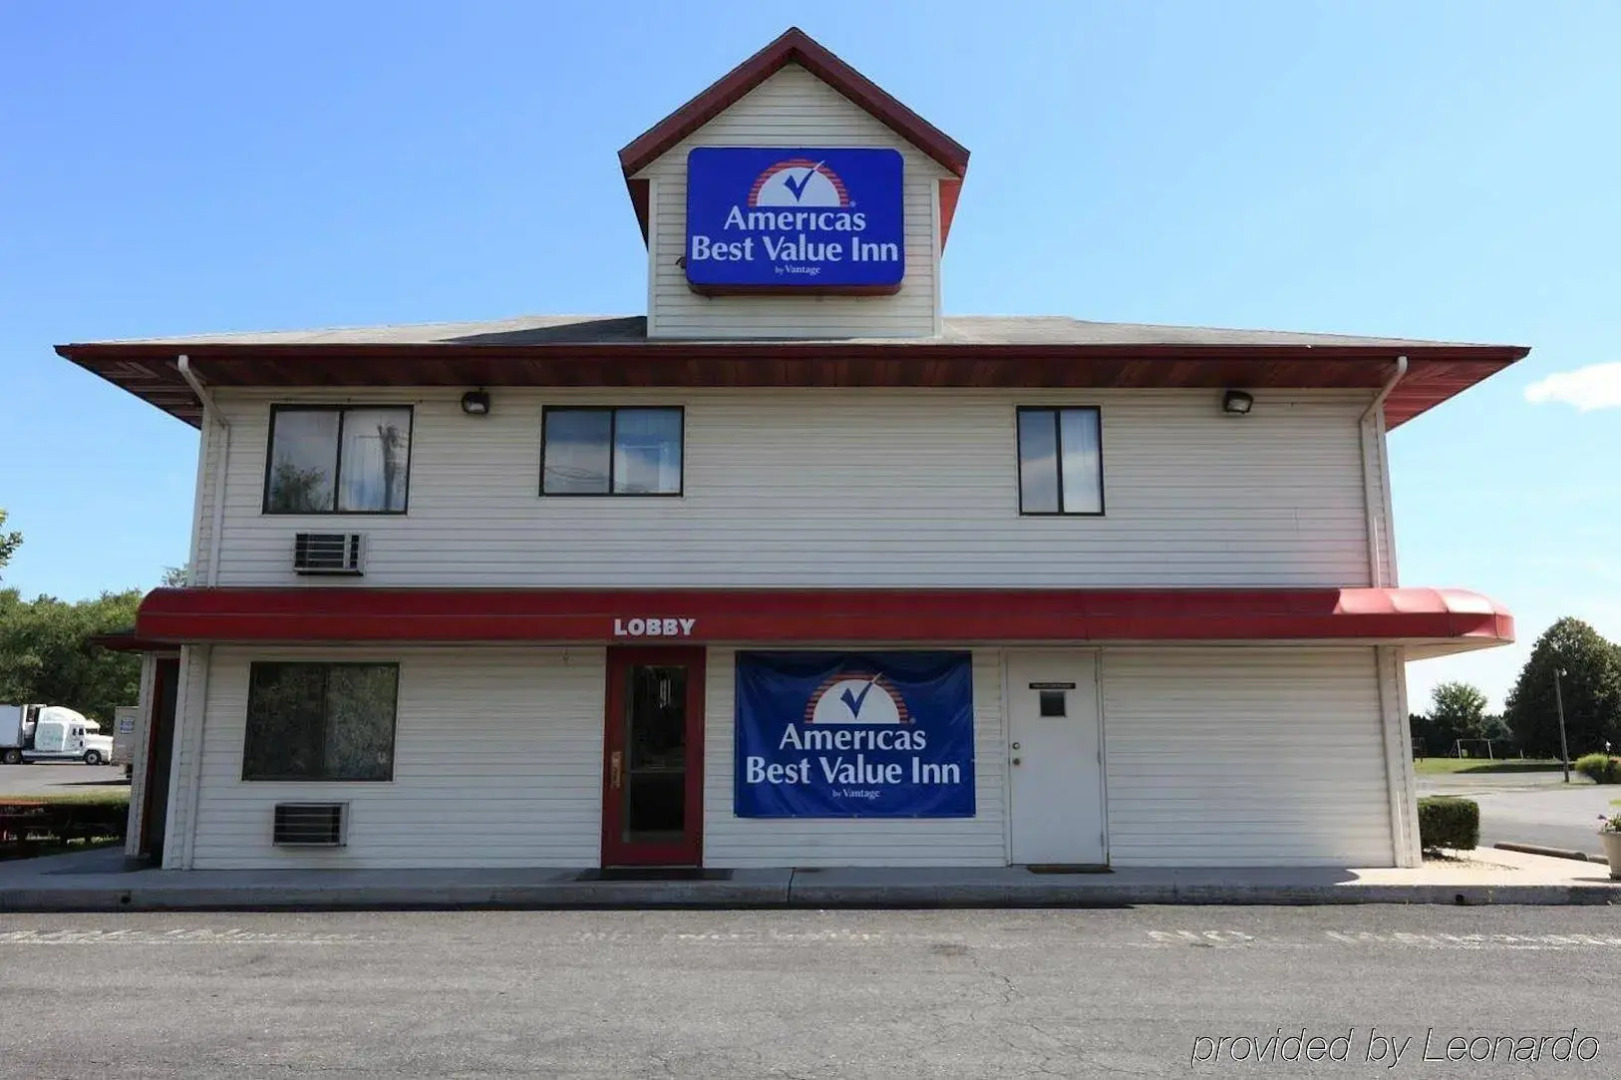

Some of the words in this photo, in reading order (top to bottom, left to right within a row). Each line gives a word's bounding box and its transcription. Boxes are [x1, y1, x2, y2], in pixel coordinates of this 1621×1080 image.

[723, 205, 867, 231] Americas
[691, 235, 755, 261] Best
[762, 234, 843, 262] Value
[852, 236, 899, 262] Inn
[775, 265, 784, 275] by
[785, 264, 821, 276] Vantage
[614, 618, 696, 636] LOBBY
[779, 722, 927, 750] Americas
[746, 756, 811, 784] Best
[819, 754, 903, 784] Value
[911, 756, 961, 784] Inn
[832, 788, 842, 799] by
[843, 788, 881, 800] Vantage
